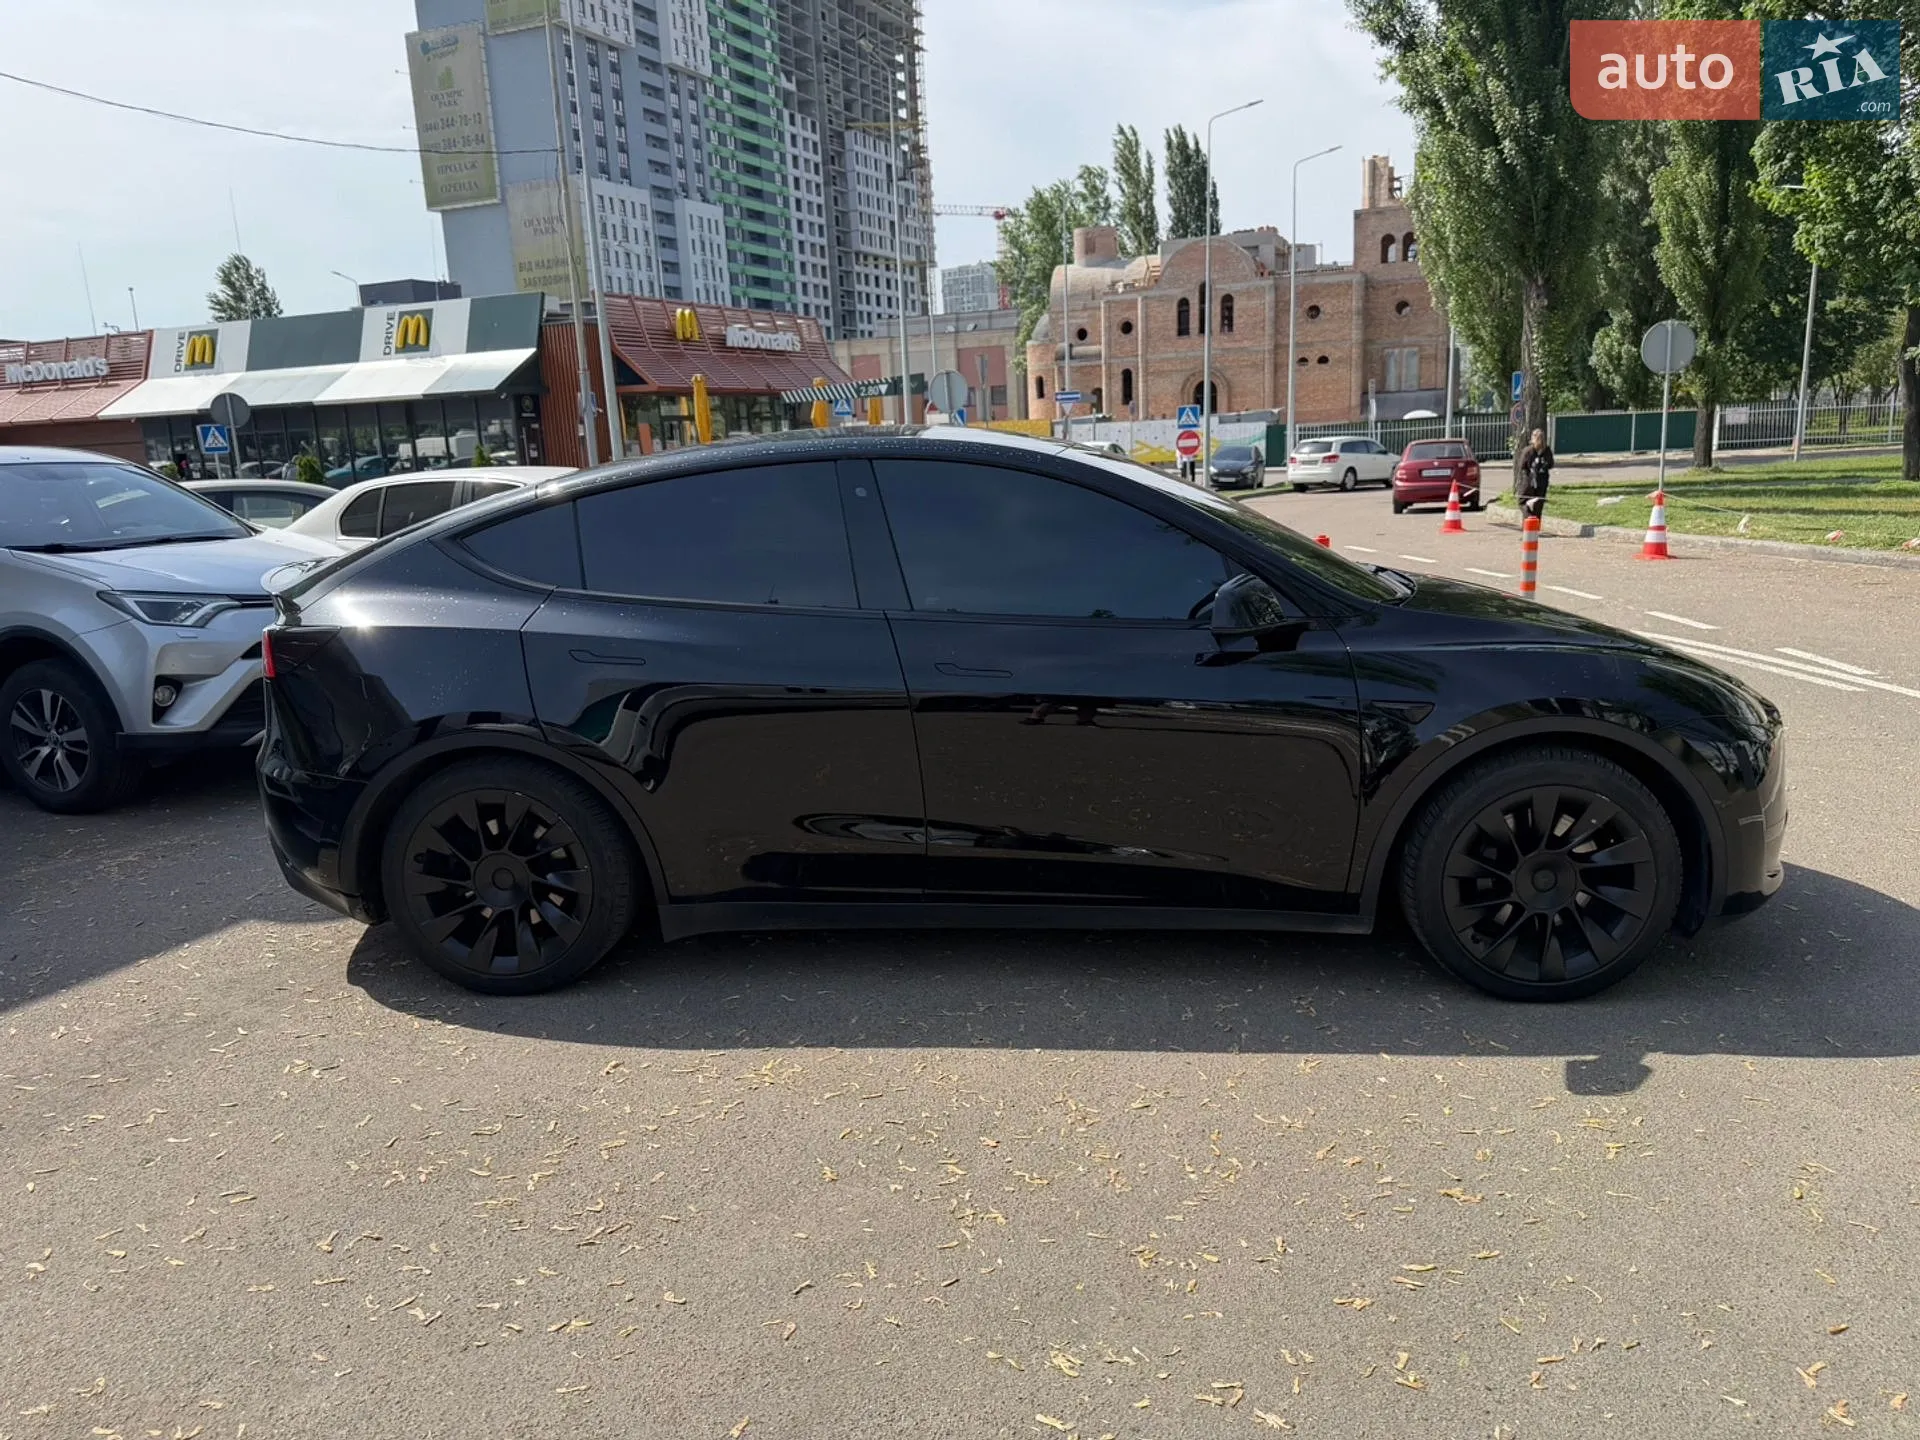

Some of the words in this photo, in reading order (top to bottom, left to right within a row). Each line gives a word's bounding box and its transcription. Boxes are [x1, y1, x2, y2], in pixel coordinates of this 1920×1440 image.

[383, 311, 396, 356] DRIVE
[725, 326, 801, 352] McDonald's
[174, 331, 186, 373] DRIVE
[5, 355, 110, 384] McDonald's
[859, 384, 880, 396] 2.80
